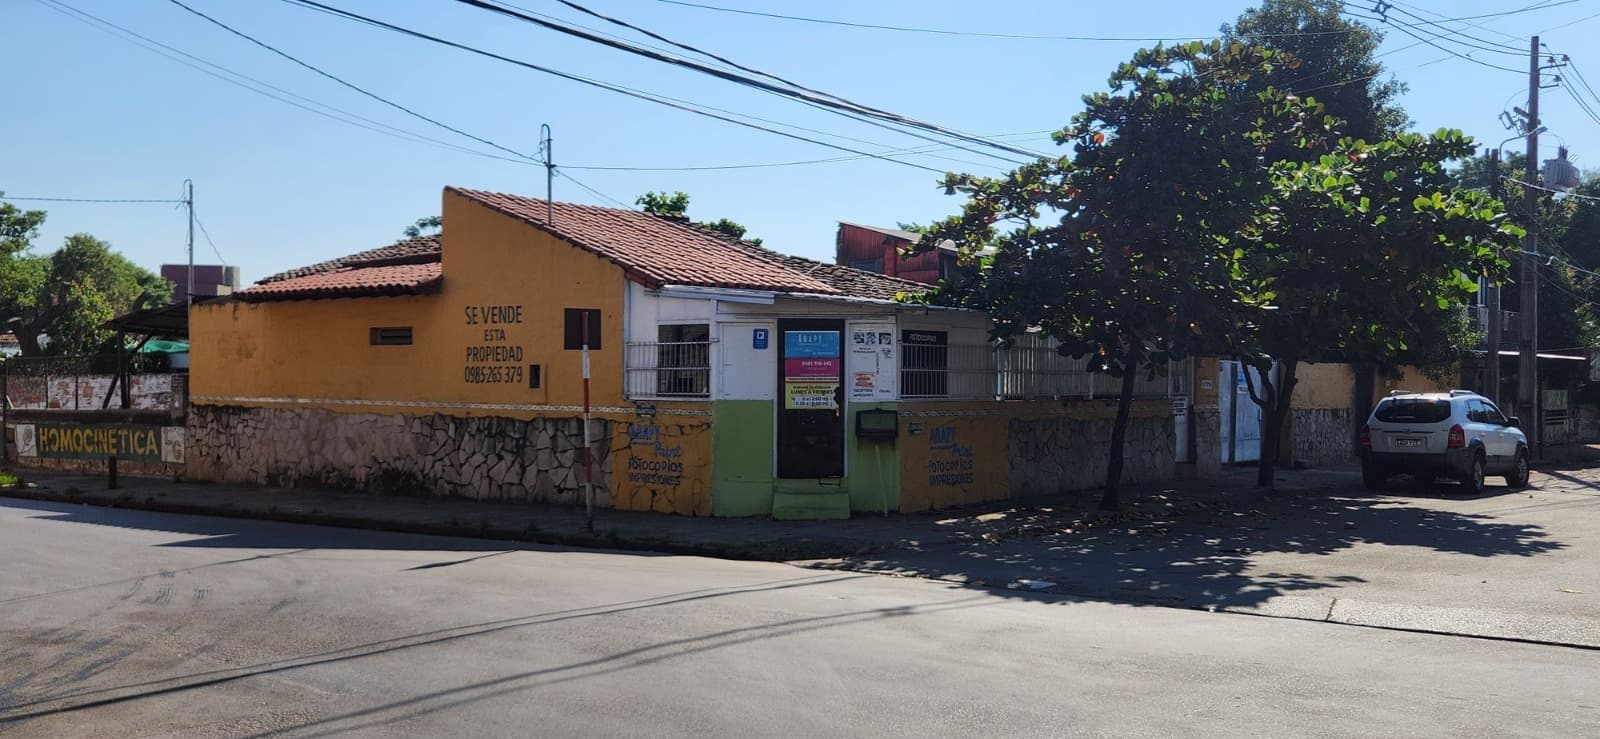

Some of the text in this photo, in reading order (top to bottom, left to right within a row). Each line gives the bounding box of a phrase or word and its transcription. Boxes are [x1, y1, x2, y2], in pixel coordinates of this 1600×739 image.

[465, 305, 523, 325] SE VENDE
[484, 329, 506, 341] ESTA
[466, 346, 523, 362] PROPIEDAD
[39, 427, 158, 456] HOMOCINETICA
